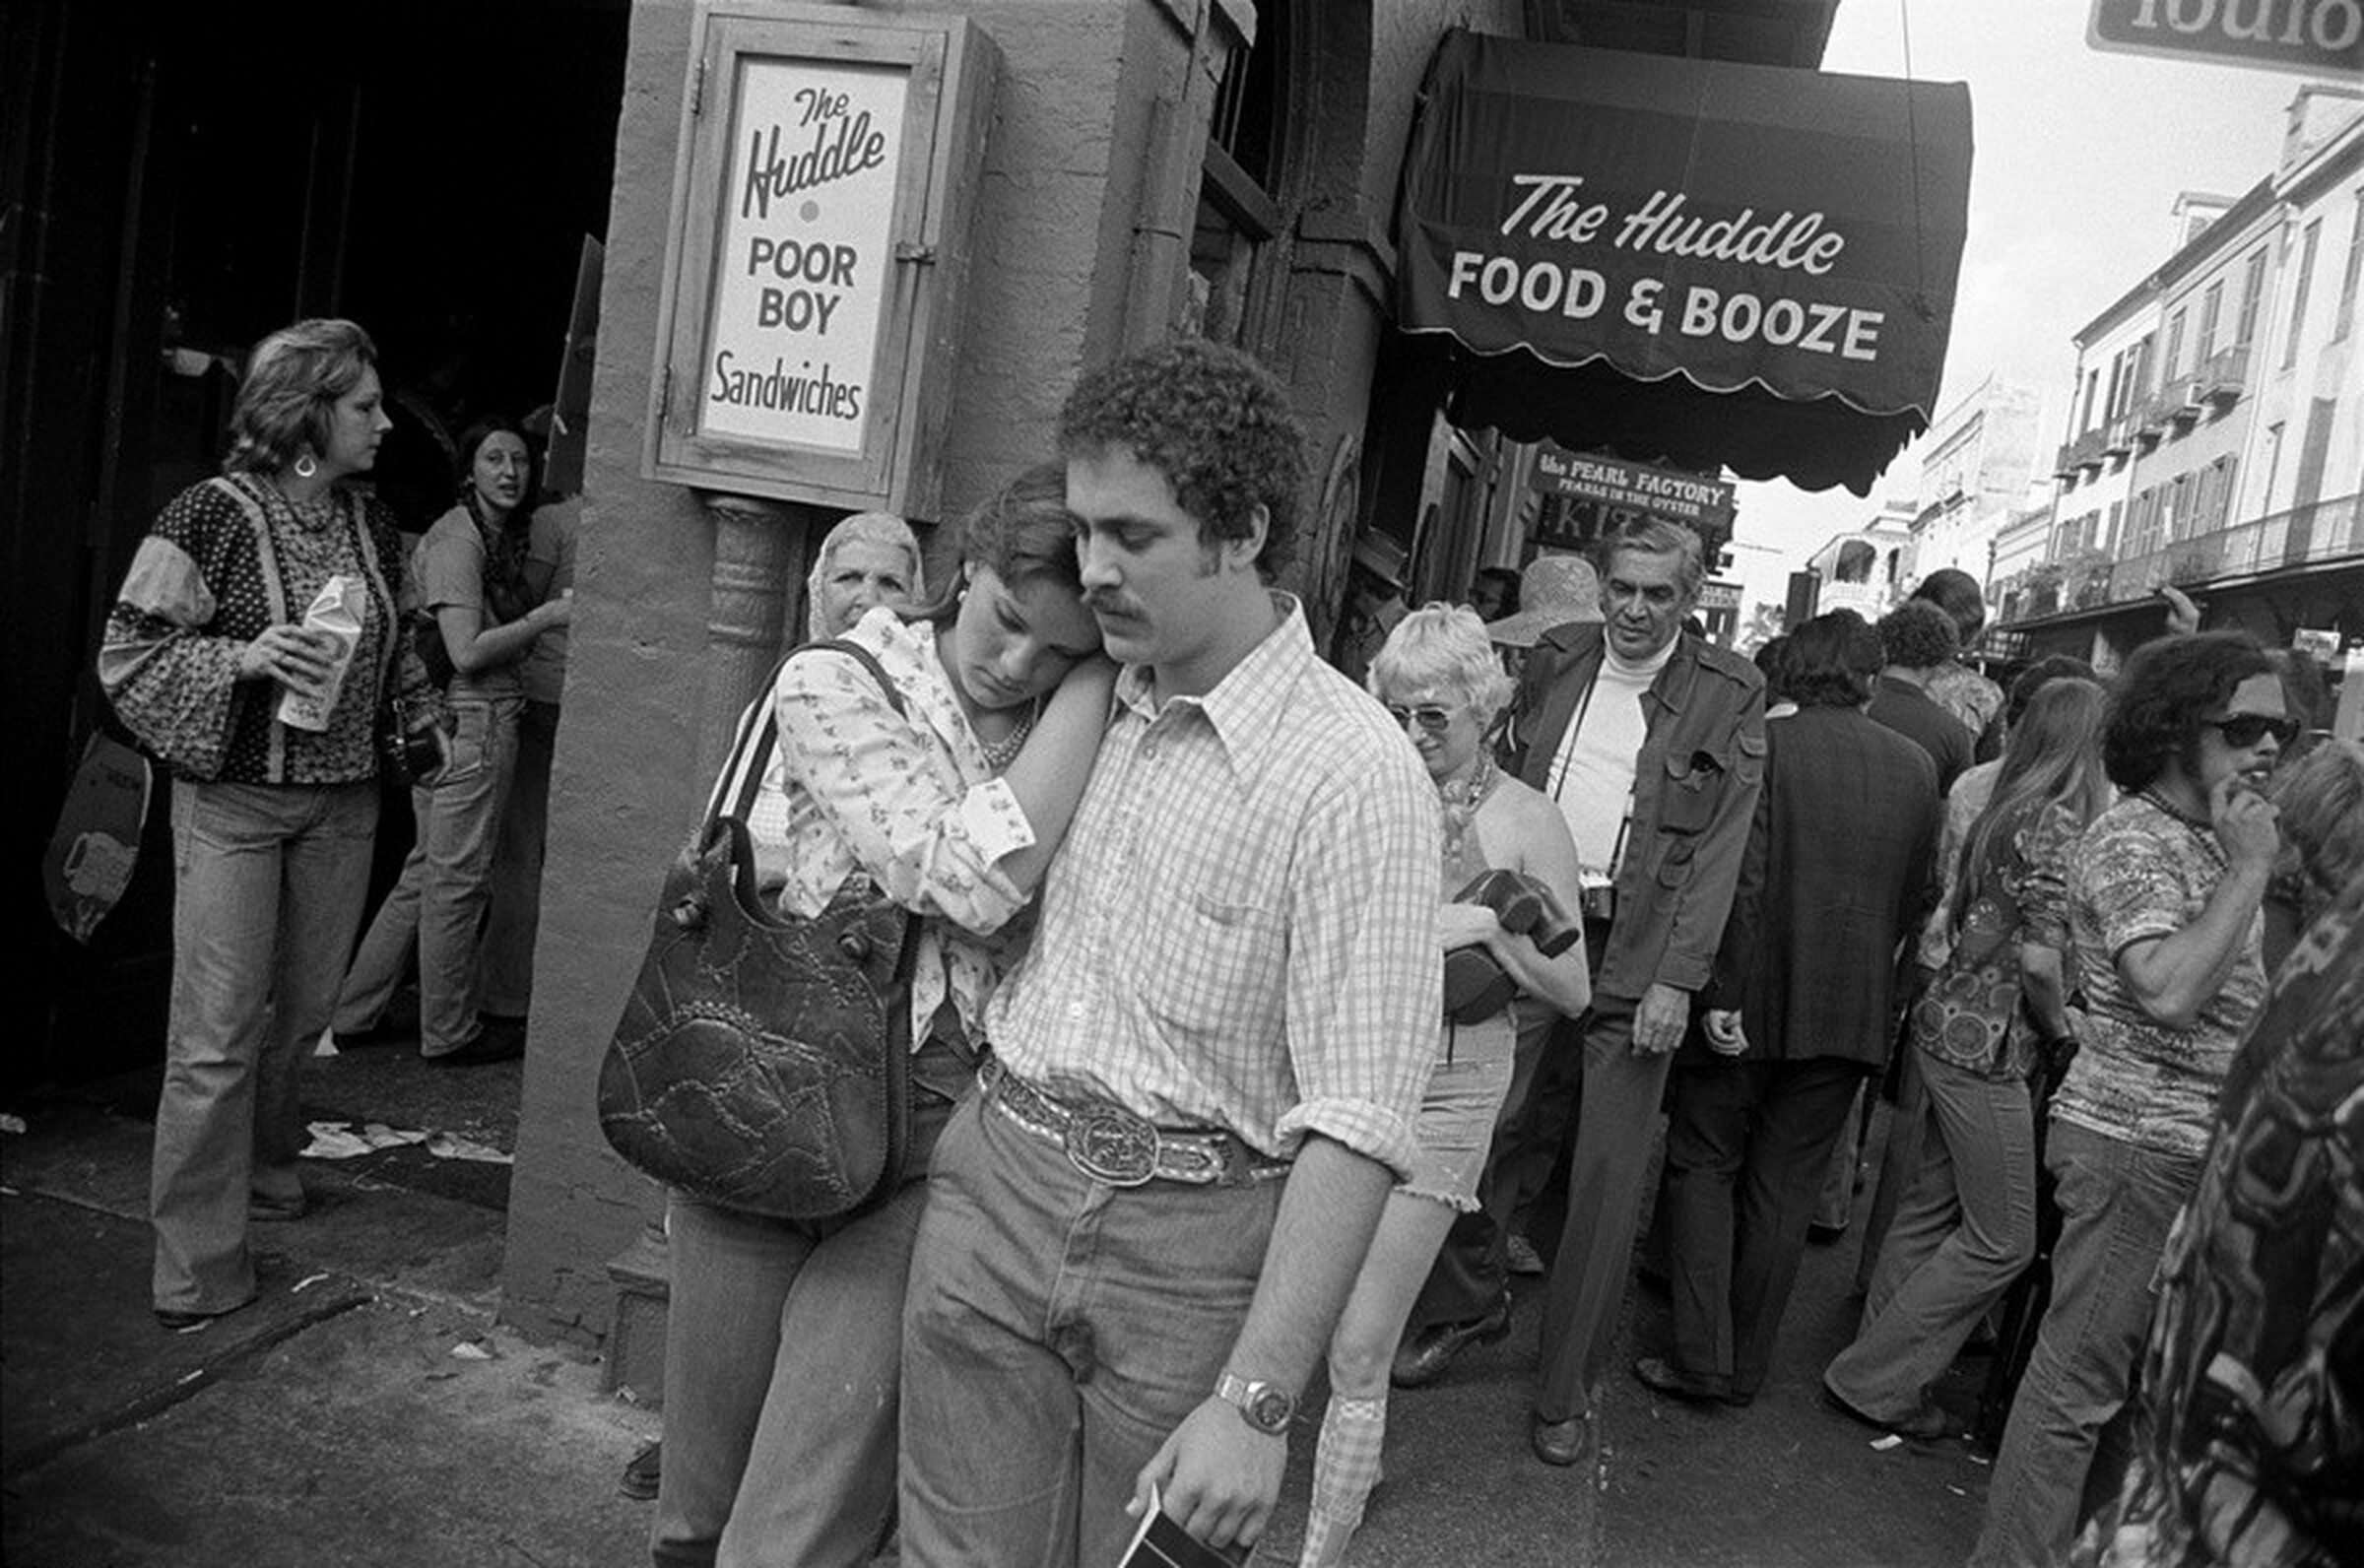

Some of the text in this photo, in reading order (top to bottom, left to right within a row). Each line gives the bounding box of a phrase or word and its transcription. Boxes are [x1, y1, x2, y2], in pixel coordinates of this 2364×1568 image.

[795, 88, 850, 126] The
[742, 110, 886, 219] Huddle
[1500, 174, 1845, 275] The Huddle
[748, 236, 858, 287] POOR
[757, 288, 842, 335] BOY
[1448, 251, 1885, 361] FOOD & BOOZE
[710, 350, 863, 421] Sandwiches
[1540, 454, 1726, 506] the PEARL FACTORY
[1558, 478, 1701, 516] PEARLS IN THE OYSTER
